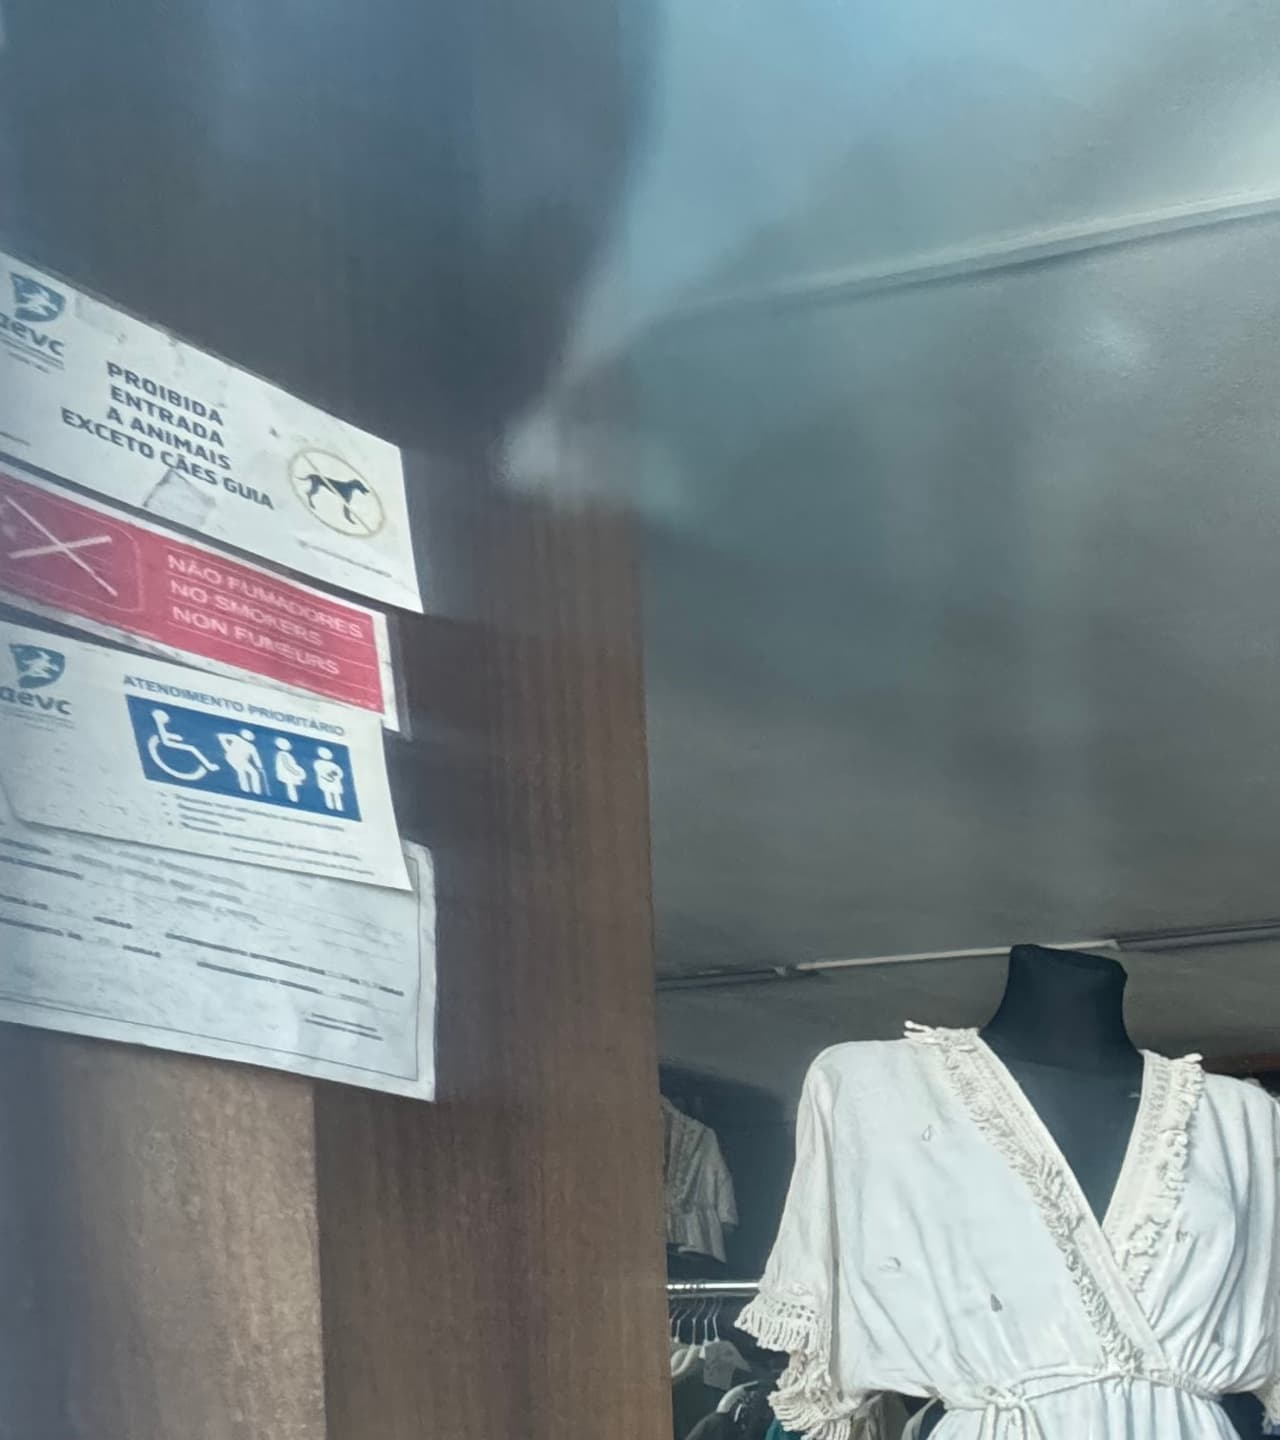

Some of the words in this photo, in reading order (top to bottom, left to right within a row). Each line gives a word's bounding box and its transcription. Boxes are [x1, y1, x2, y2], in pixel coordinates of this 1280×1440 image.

[106, 360, 224, 427] PROIBIDA
[110, 383, 225, 448] ENTRADA
[61, 406, 154, 459] EXCETO
[160, 450, 219, 486] CÃES
[222, 476, 275, 510] GUIA
[106, 406, 124, 426] A
[130, 416, 232, 471] ANIMAIS
[170, 579, 208, 604] NO
[213, 595, 323, 646] SMOKERS
[226, 575, 364, 639] FUMADORES
[172, 606, 228, 636] NON
[231, 625, 340, 676] FUMEURS
[124, 675, 245, 712] ATENDIMENTO
